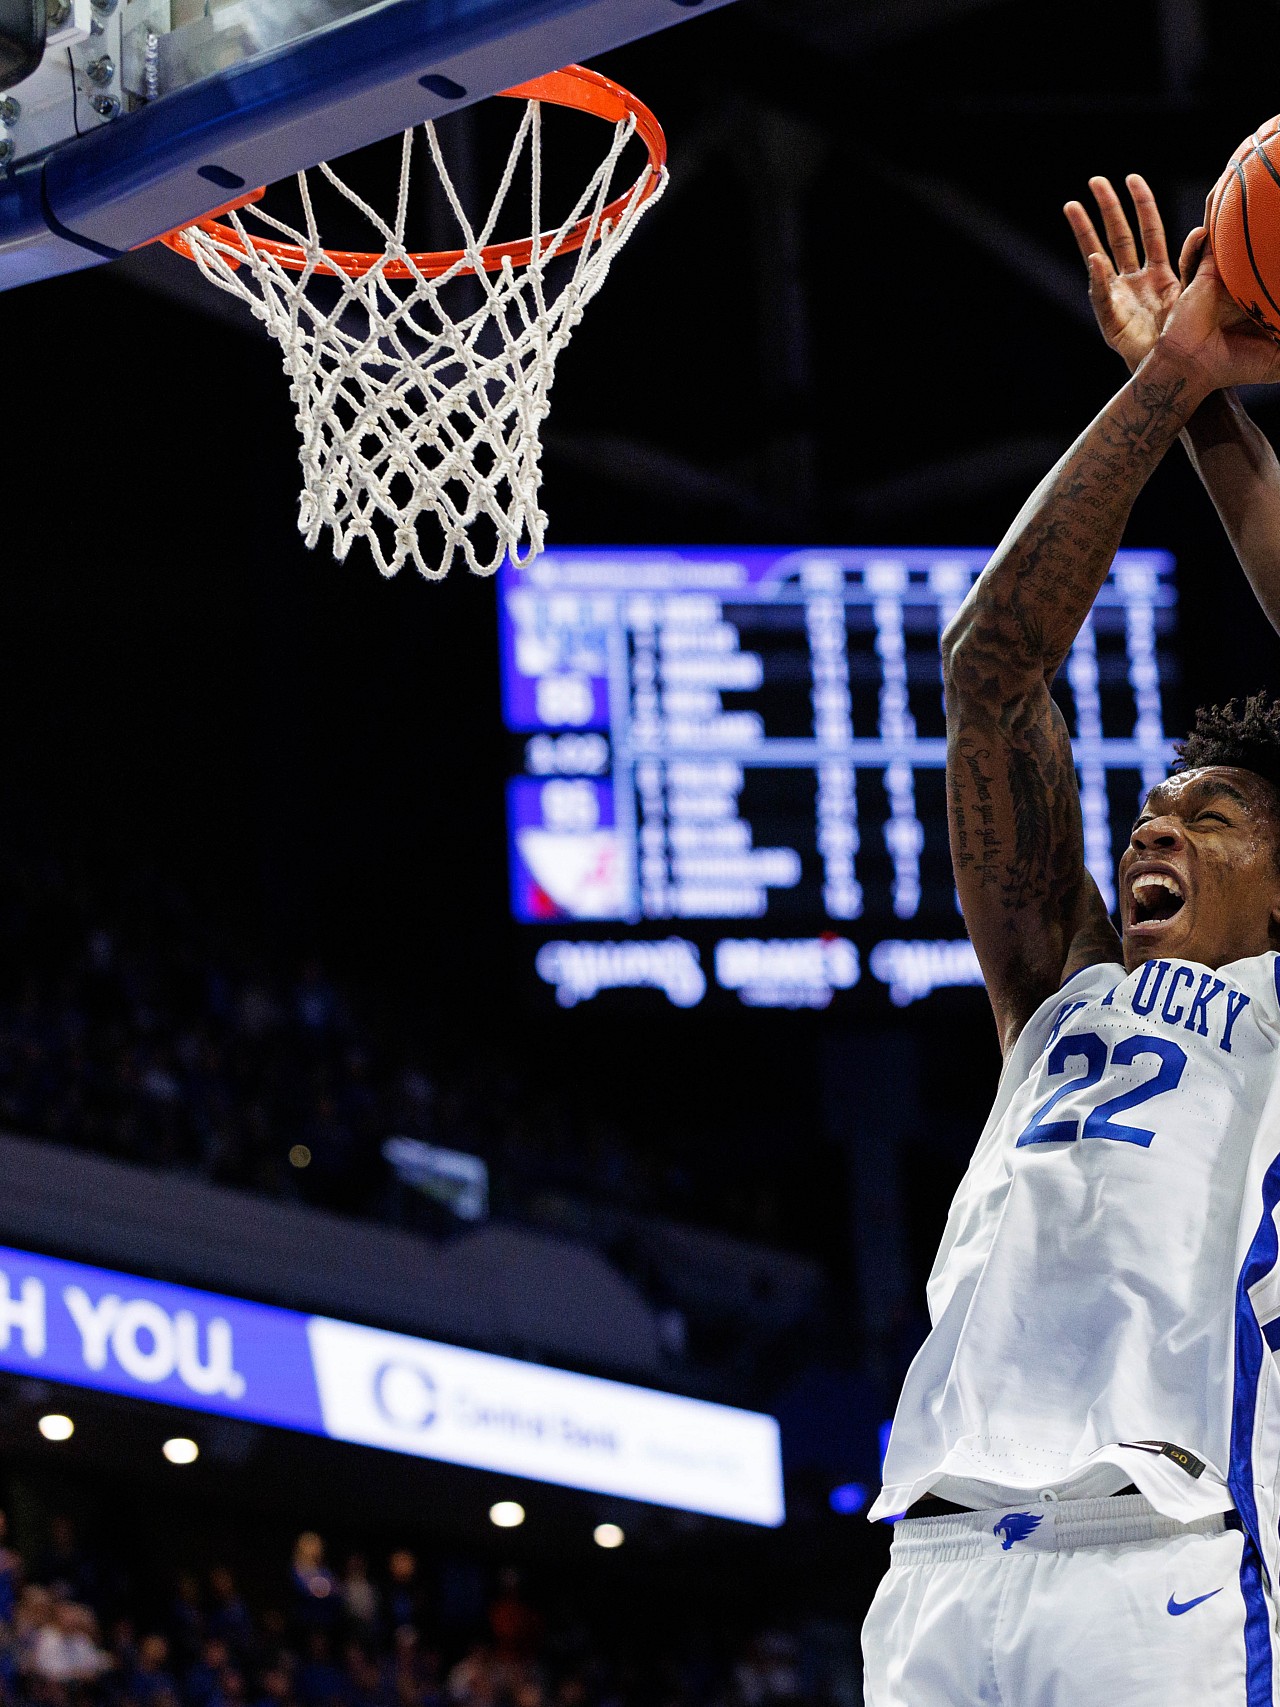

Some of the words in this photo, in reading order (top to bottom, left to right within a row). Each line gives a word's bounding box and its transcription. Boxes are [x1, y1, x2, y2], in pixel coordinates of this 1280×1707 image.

[1045, 958, 1250, 1054] KUCKY
[1016, 1032, 1188, 1148] 22
[62, 1284, 248, 1400] YOU.
